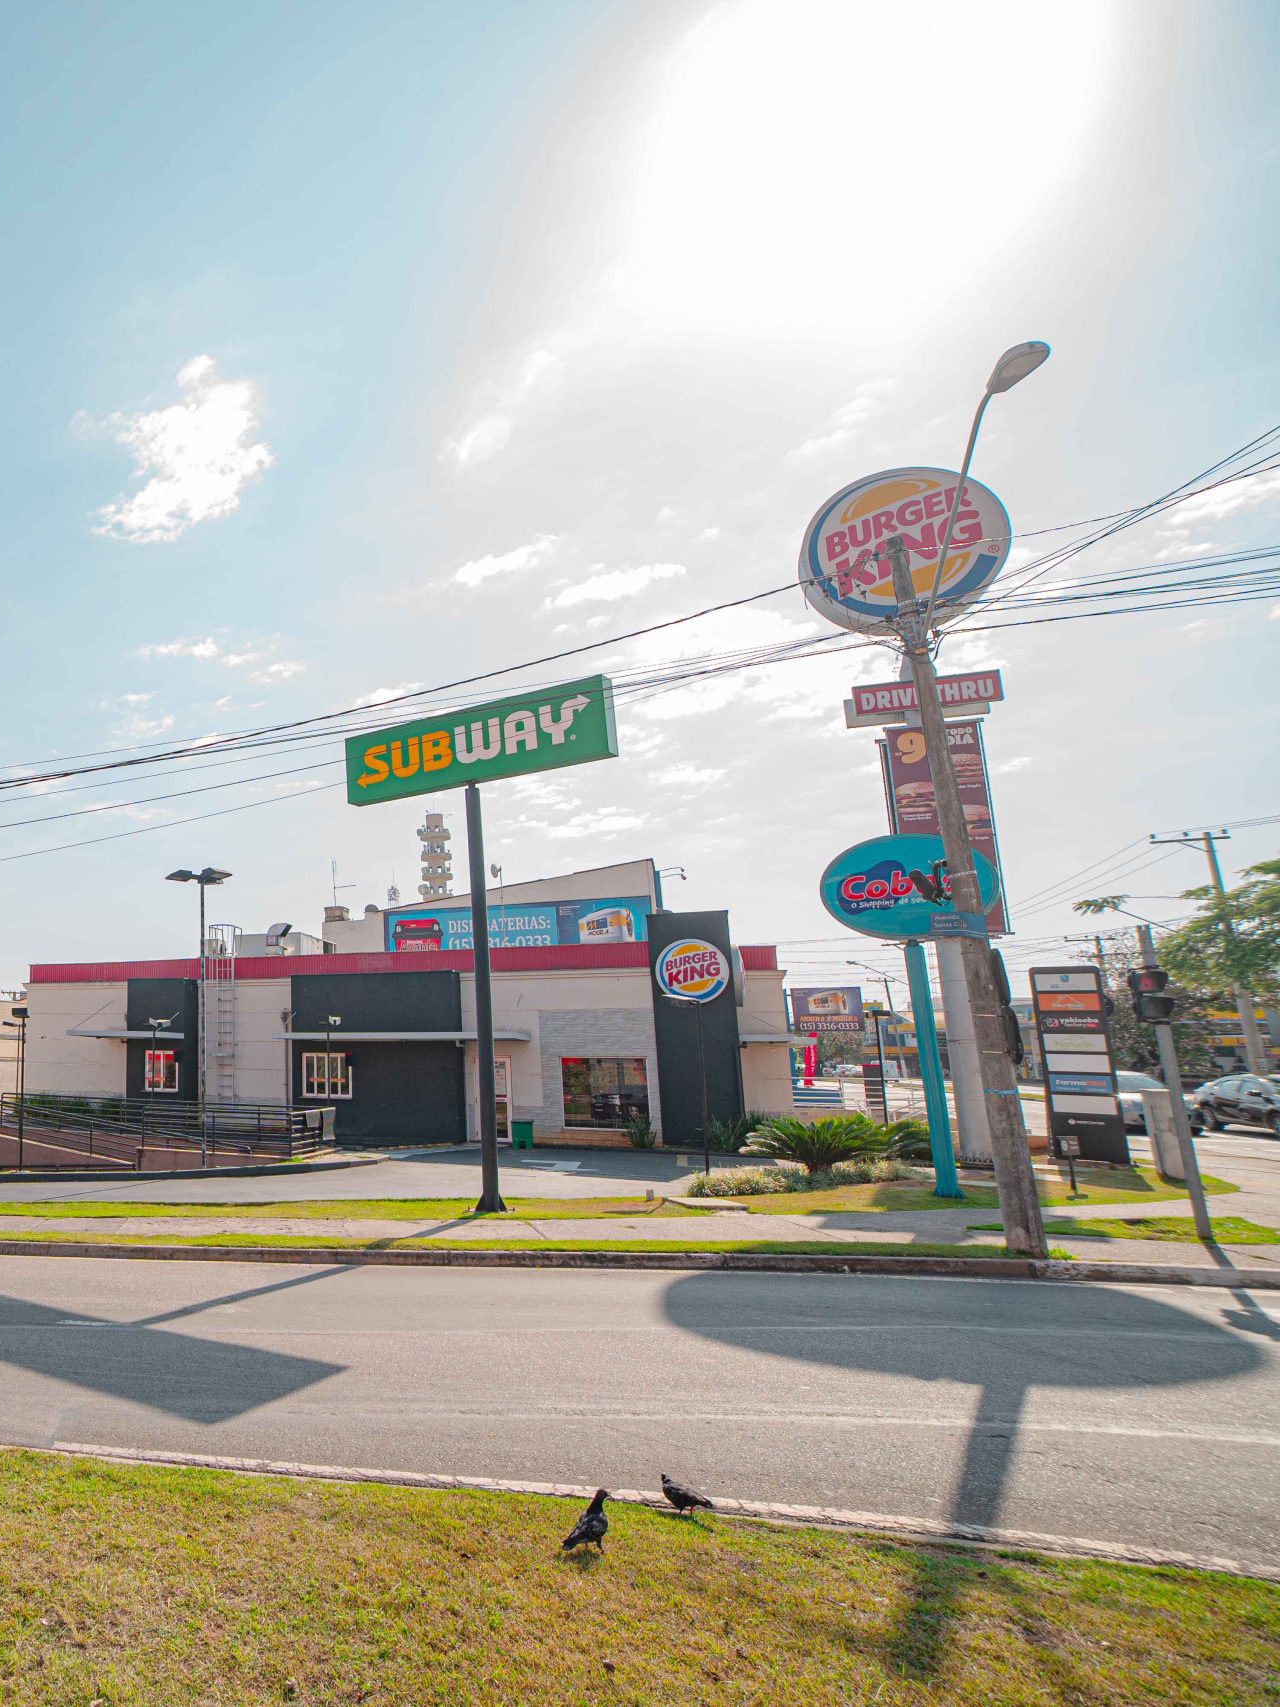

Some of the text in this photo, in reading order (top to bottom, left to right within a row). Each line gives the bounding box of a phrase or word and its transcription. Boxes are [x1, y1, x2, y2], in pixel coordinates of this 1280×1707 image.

[825, 486, 972, 562] BURGER
[835, 510, 983, 599] KING
[935, 678, 995, 702] THRU
[357, 695, 590, 788] SUBWAY
[896, 731, 927, 764] 9
[948, 734, 974, 746] DIA
[448, 916, 551, 933] DIS ATERIAS:
[587, 929, 610, 937] MOURA
[488, 935, 551, 949] 316-0333
[665, 950, 718, 972] BURGER
[668, 961, 721, 988] KING
[800, 1022, 859, 1030] (15) 3316-0333
[1059, 1016, 1099, 1024] yakisoba
